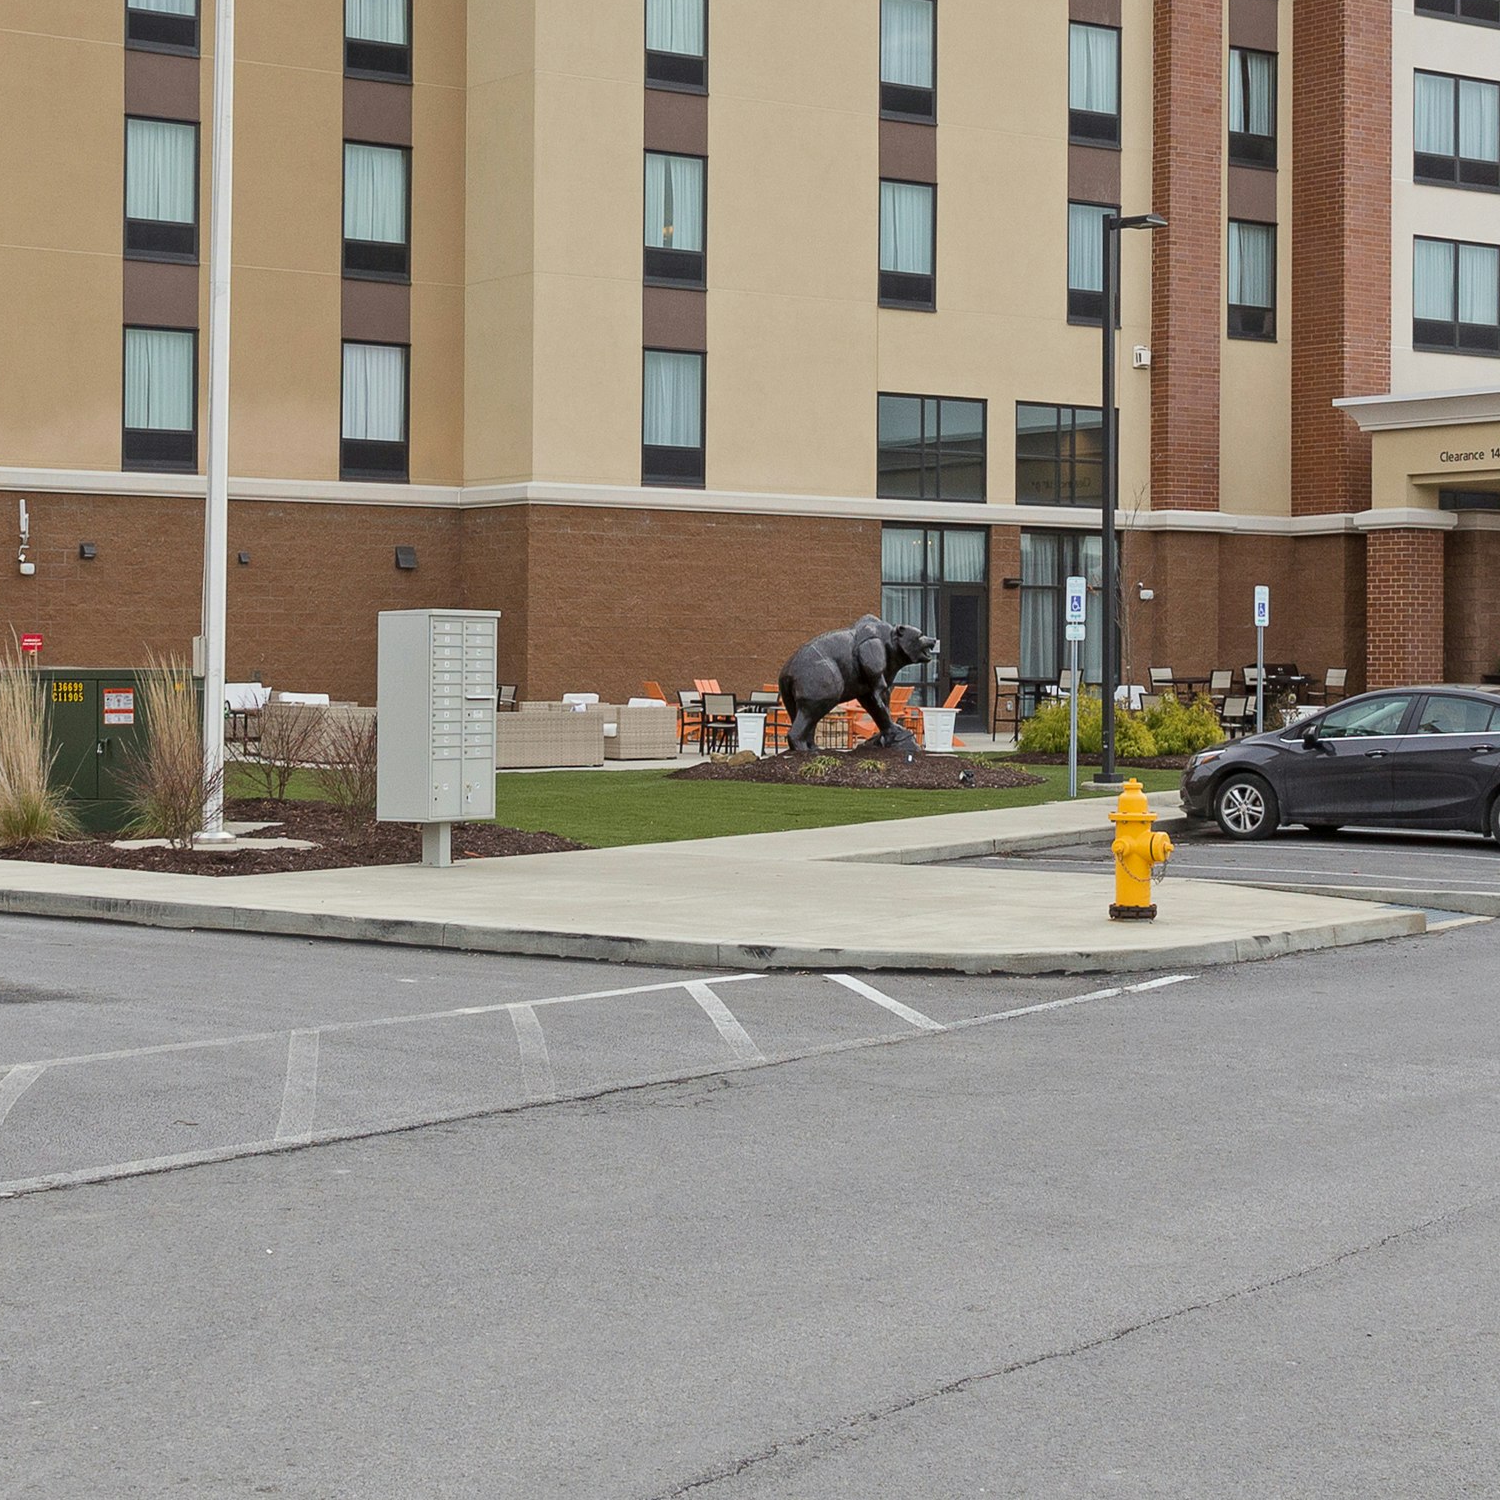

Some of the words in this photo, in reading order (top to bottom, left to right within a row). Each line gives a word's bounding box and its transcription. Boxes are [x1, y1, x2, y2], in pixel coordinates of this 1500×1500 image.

[1440, 451, 1485, 462] Clearance
[52, 681, 84, 692] 136699
[52, 691, 84, 703] C11905
